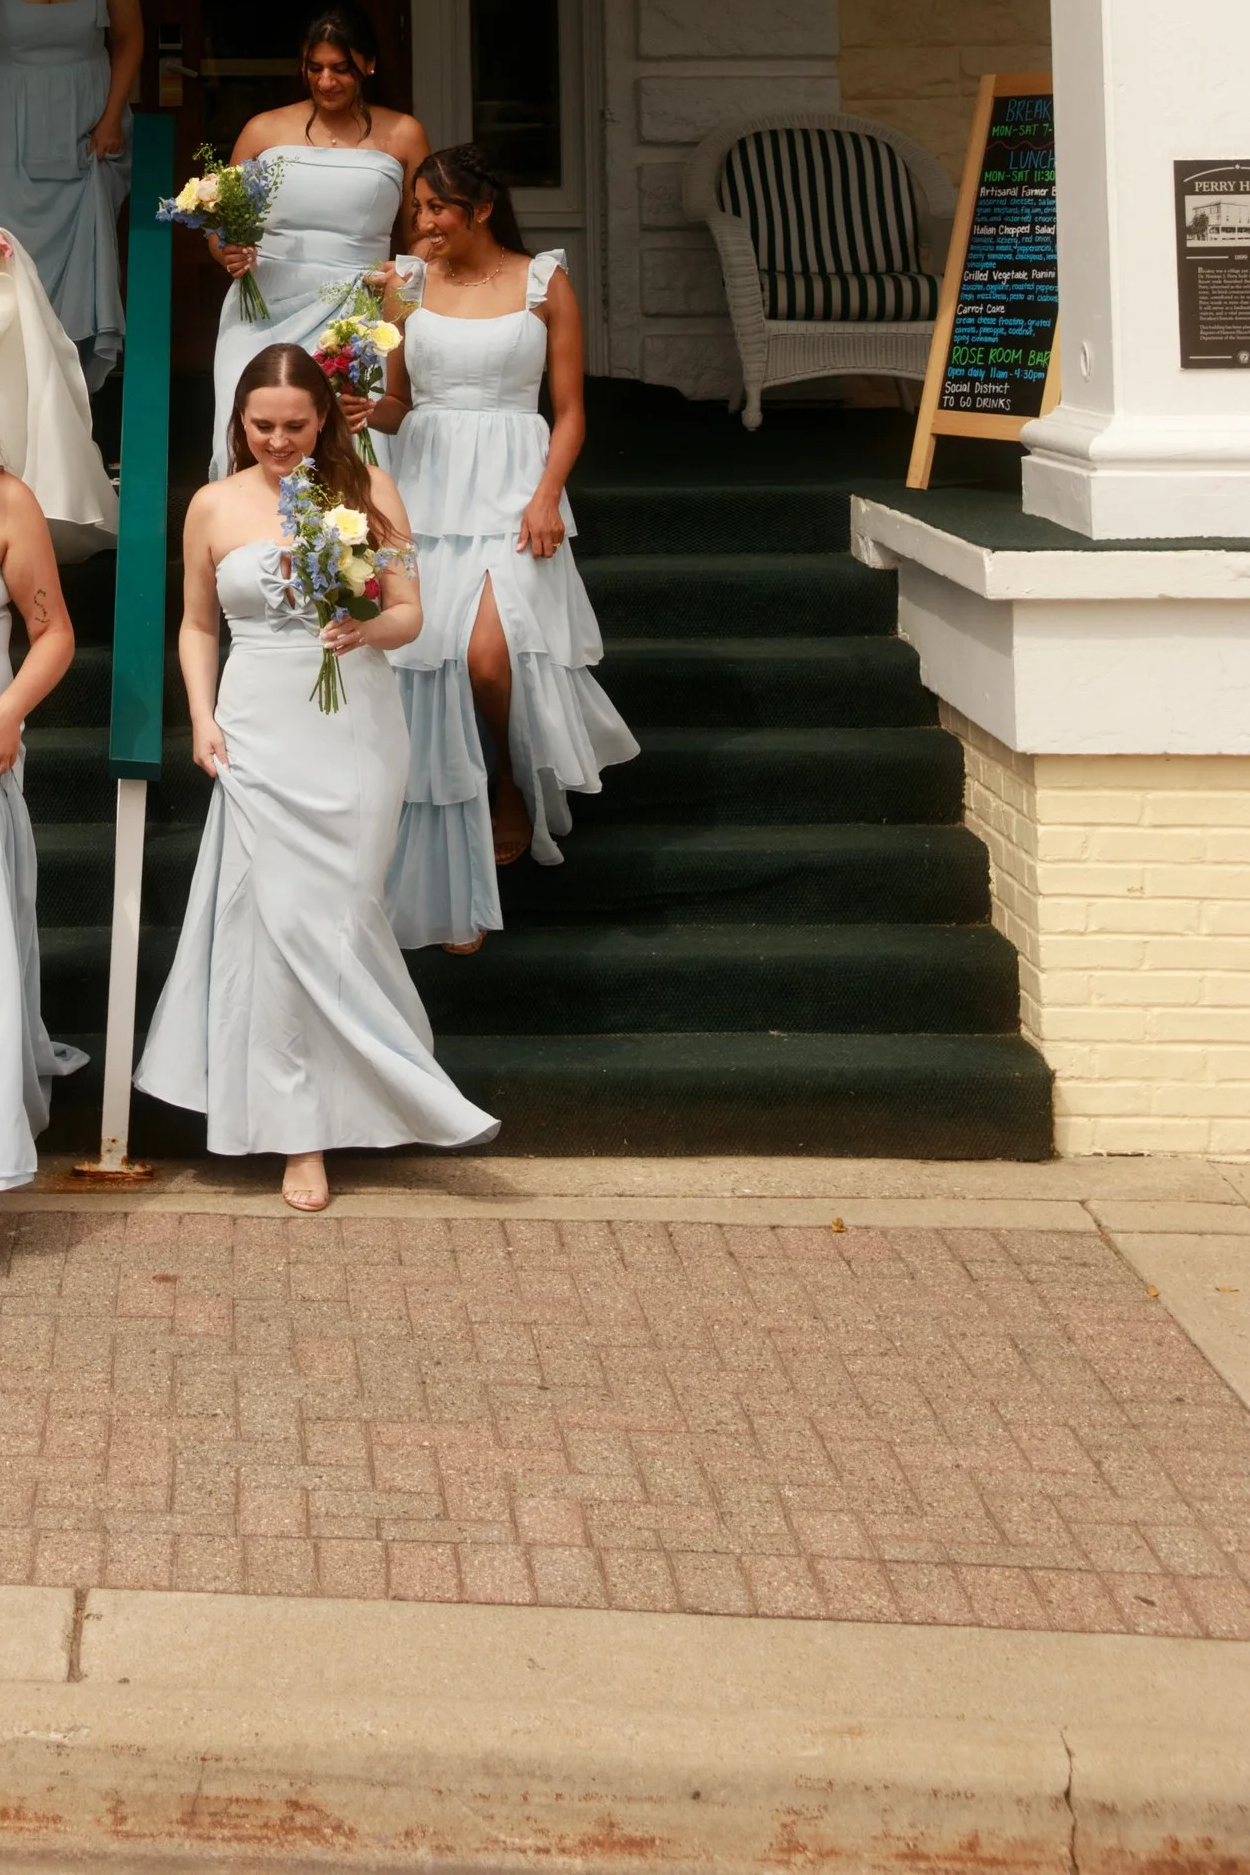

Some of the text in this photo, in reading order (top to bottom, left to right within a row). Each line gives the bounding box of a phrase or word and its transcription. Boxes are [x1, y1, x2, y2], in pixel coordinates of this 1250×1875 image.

[991, 124, 1039, 137] MON-SAT
[984, 170, 1030, 182] MON-SAT
[979, 186, 1019, 197] Artisanal
[1021, 186, 1049, 197] Farmer
[1194, 181, 1236, 192] PERRY
[973, 224, 1056, 237] Italian Chopped Salad
[963, 267, 1056, 285] Grilled Vegetable Panini
[957, 303, 1006, 315] Carrot Cake
[1027, 318, 1051, 329] grated
[951, 346, 1052, 368] ROSE ROOM BAR
[947, 366, 965, 379] Open
[967, 367, 985, 381] daily
[945, 381, 1010, 395] Social District
[942, 396, 1012, 411] TO GO DRINKS
